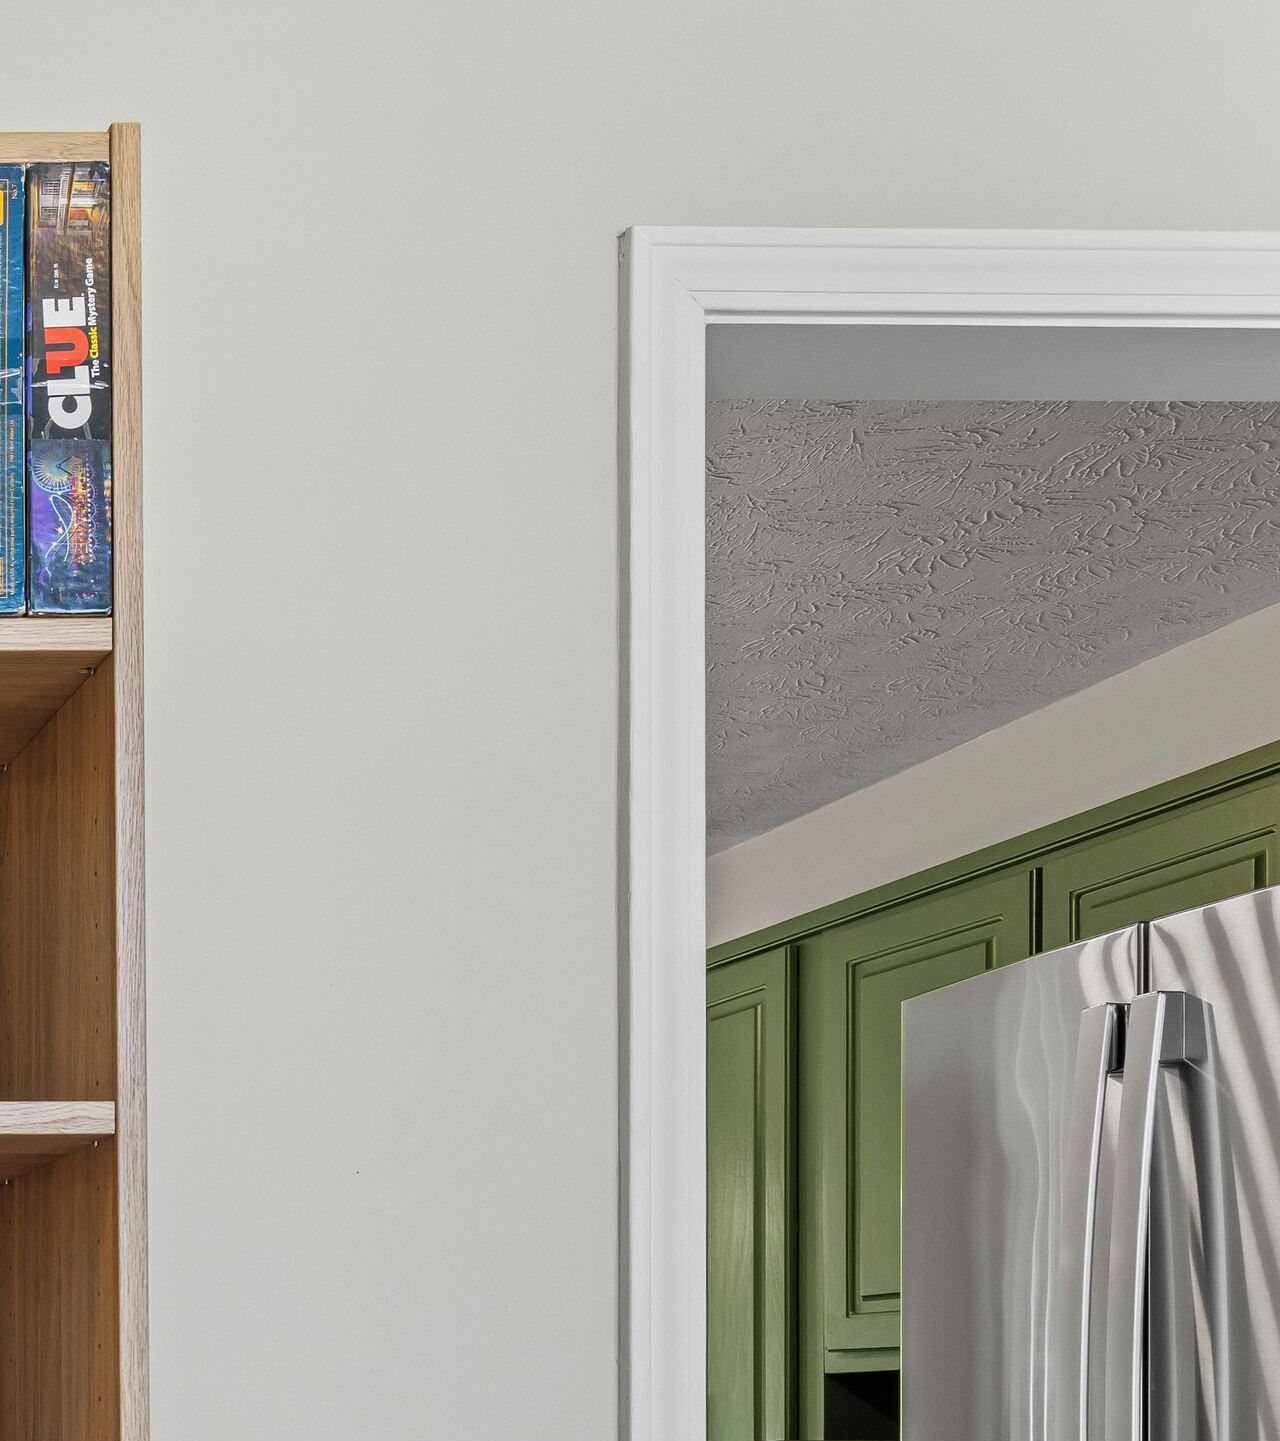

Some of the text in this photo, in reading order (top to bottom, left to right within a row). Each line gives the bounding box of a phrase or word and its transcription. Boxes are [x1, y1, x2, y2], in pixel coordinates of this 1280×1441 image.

[42, 296, 92, 430] CLUE
[83, 258, 100, 378] The Classic Mystery Game
